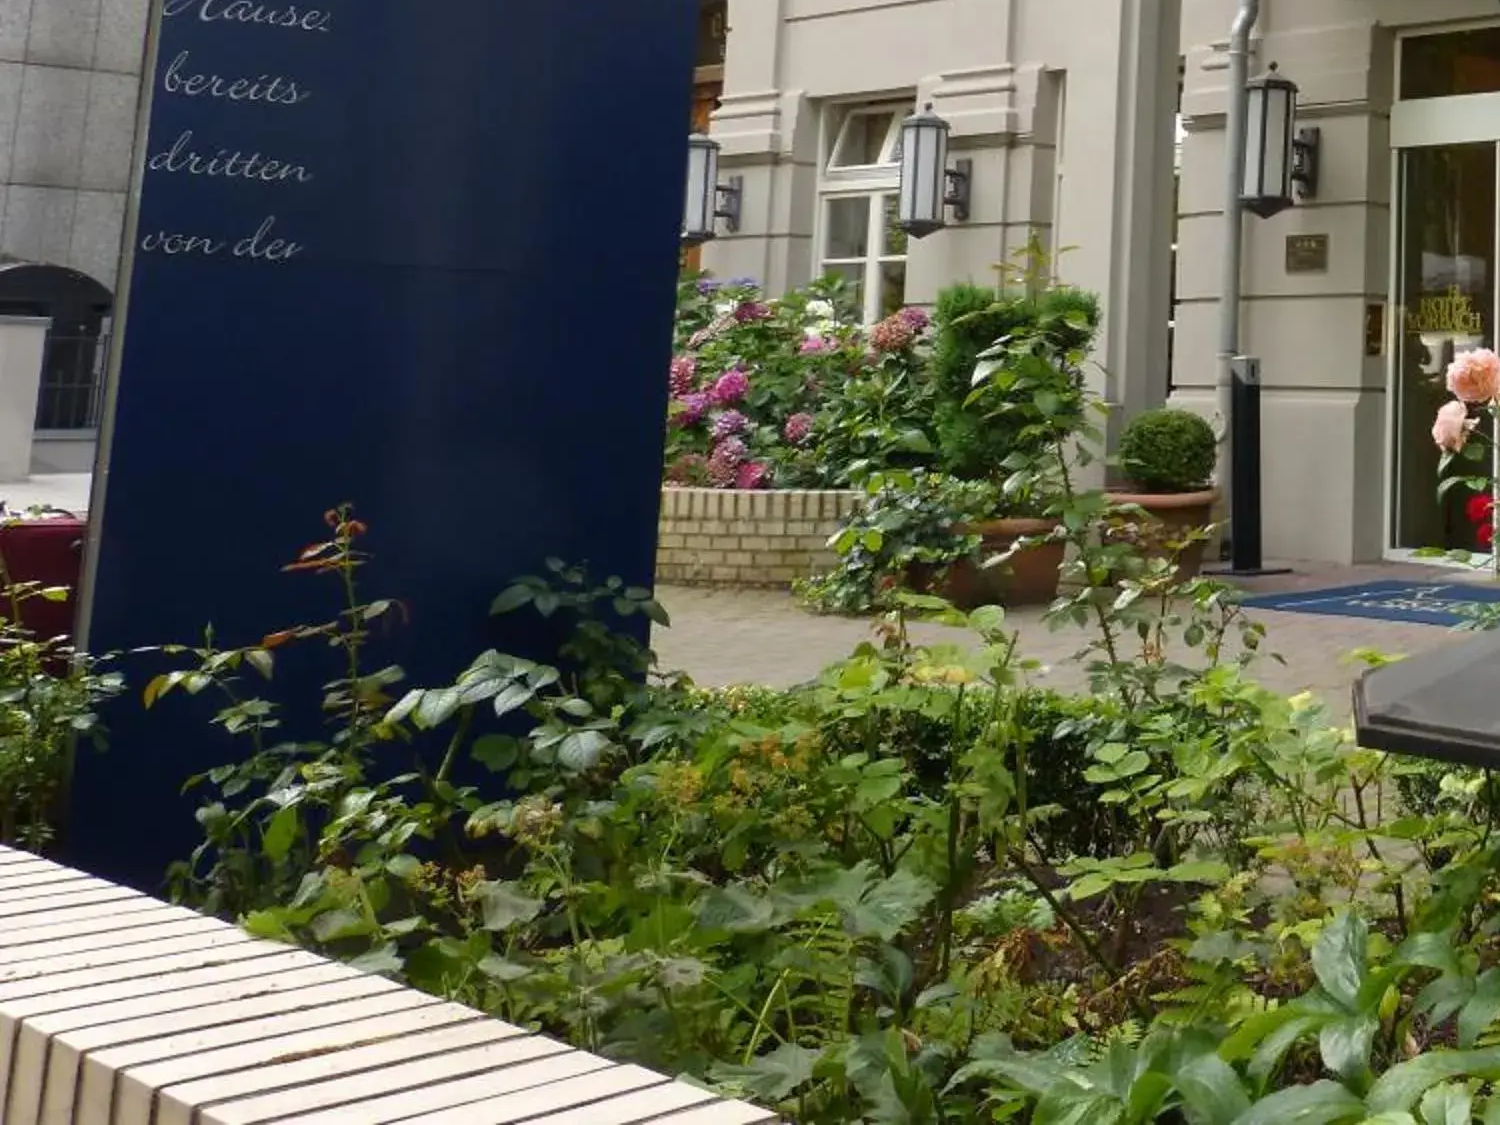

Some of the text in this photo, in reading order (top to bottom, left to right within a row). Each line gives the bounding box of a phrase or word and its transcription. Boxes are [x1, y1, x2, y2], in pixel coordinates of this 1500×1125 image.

[163, 49, 311, 105] bereits
[149, 129, 313, 183] dritten
[141, 230, 226, 255] von
